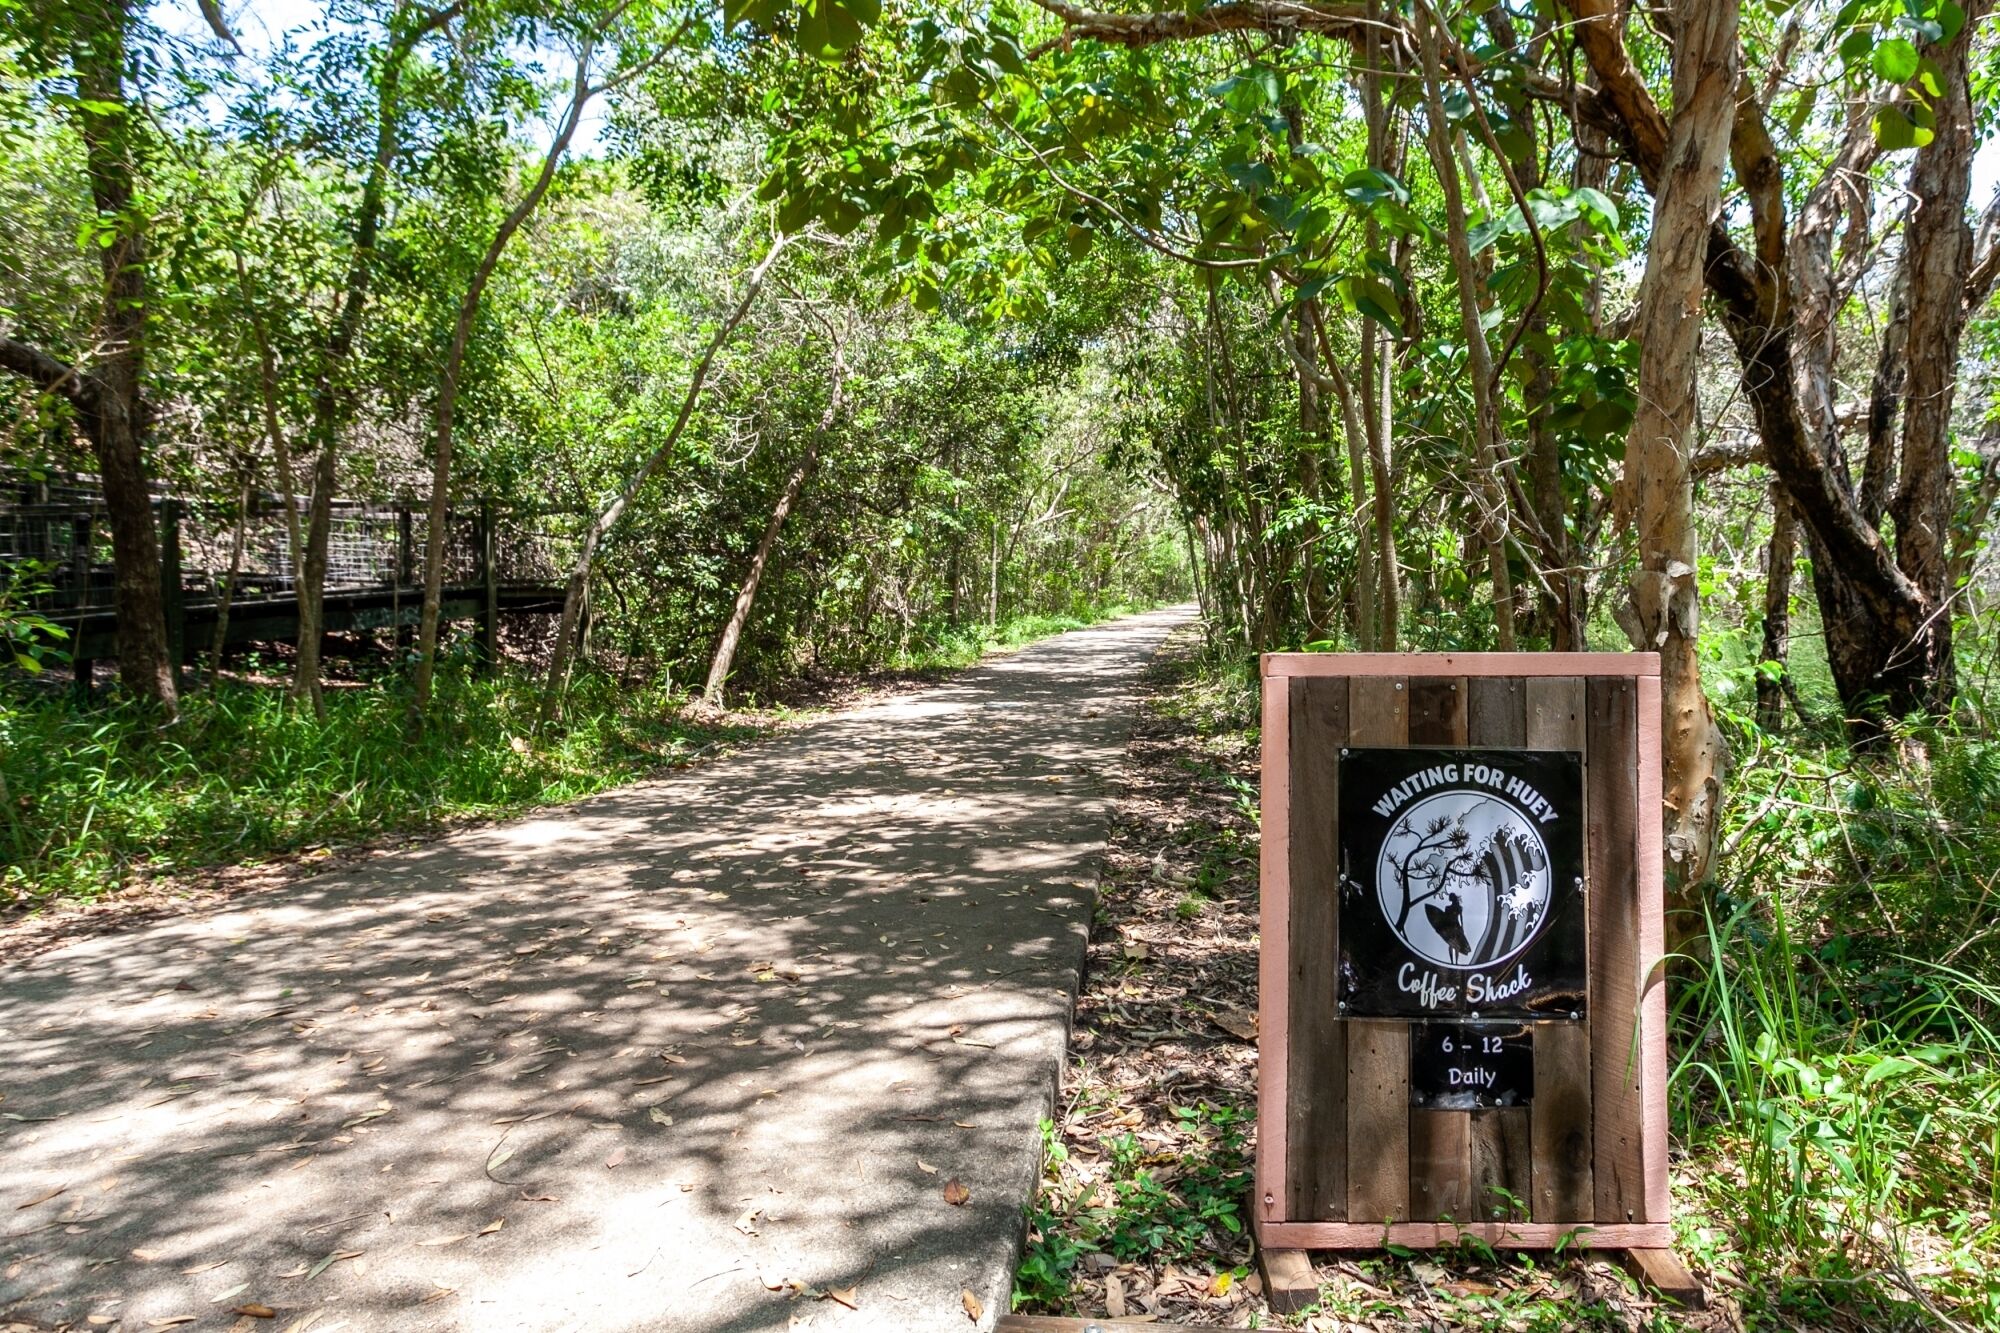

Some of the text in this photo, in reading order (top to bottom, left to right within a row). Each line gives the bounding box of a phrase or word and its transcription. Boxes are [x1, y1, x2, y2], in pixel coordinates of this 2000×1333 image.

[1372, 763, 1559, 825] WAITING FOR HUEY
[1397, 962, 1532, 1010] Coffee Shack
[1441, 1036, 1454, 1053] 6
[1482, 1036, 1504, 1053] 12
[1448, 1066, 1497, 1089] Daily
